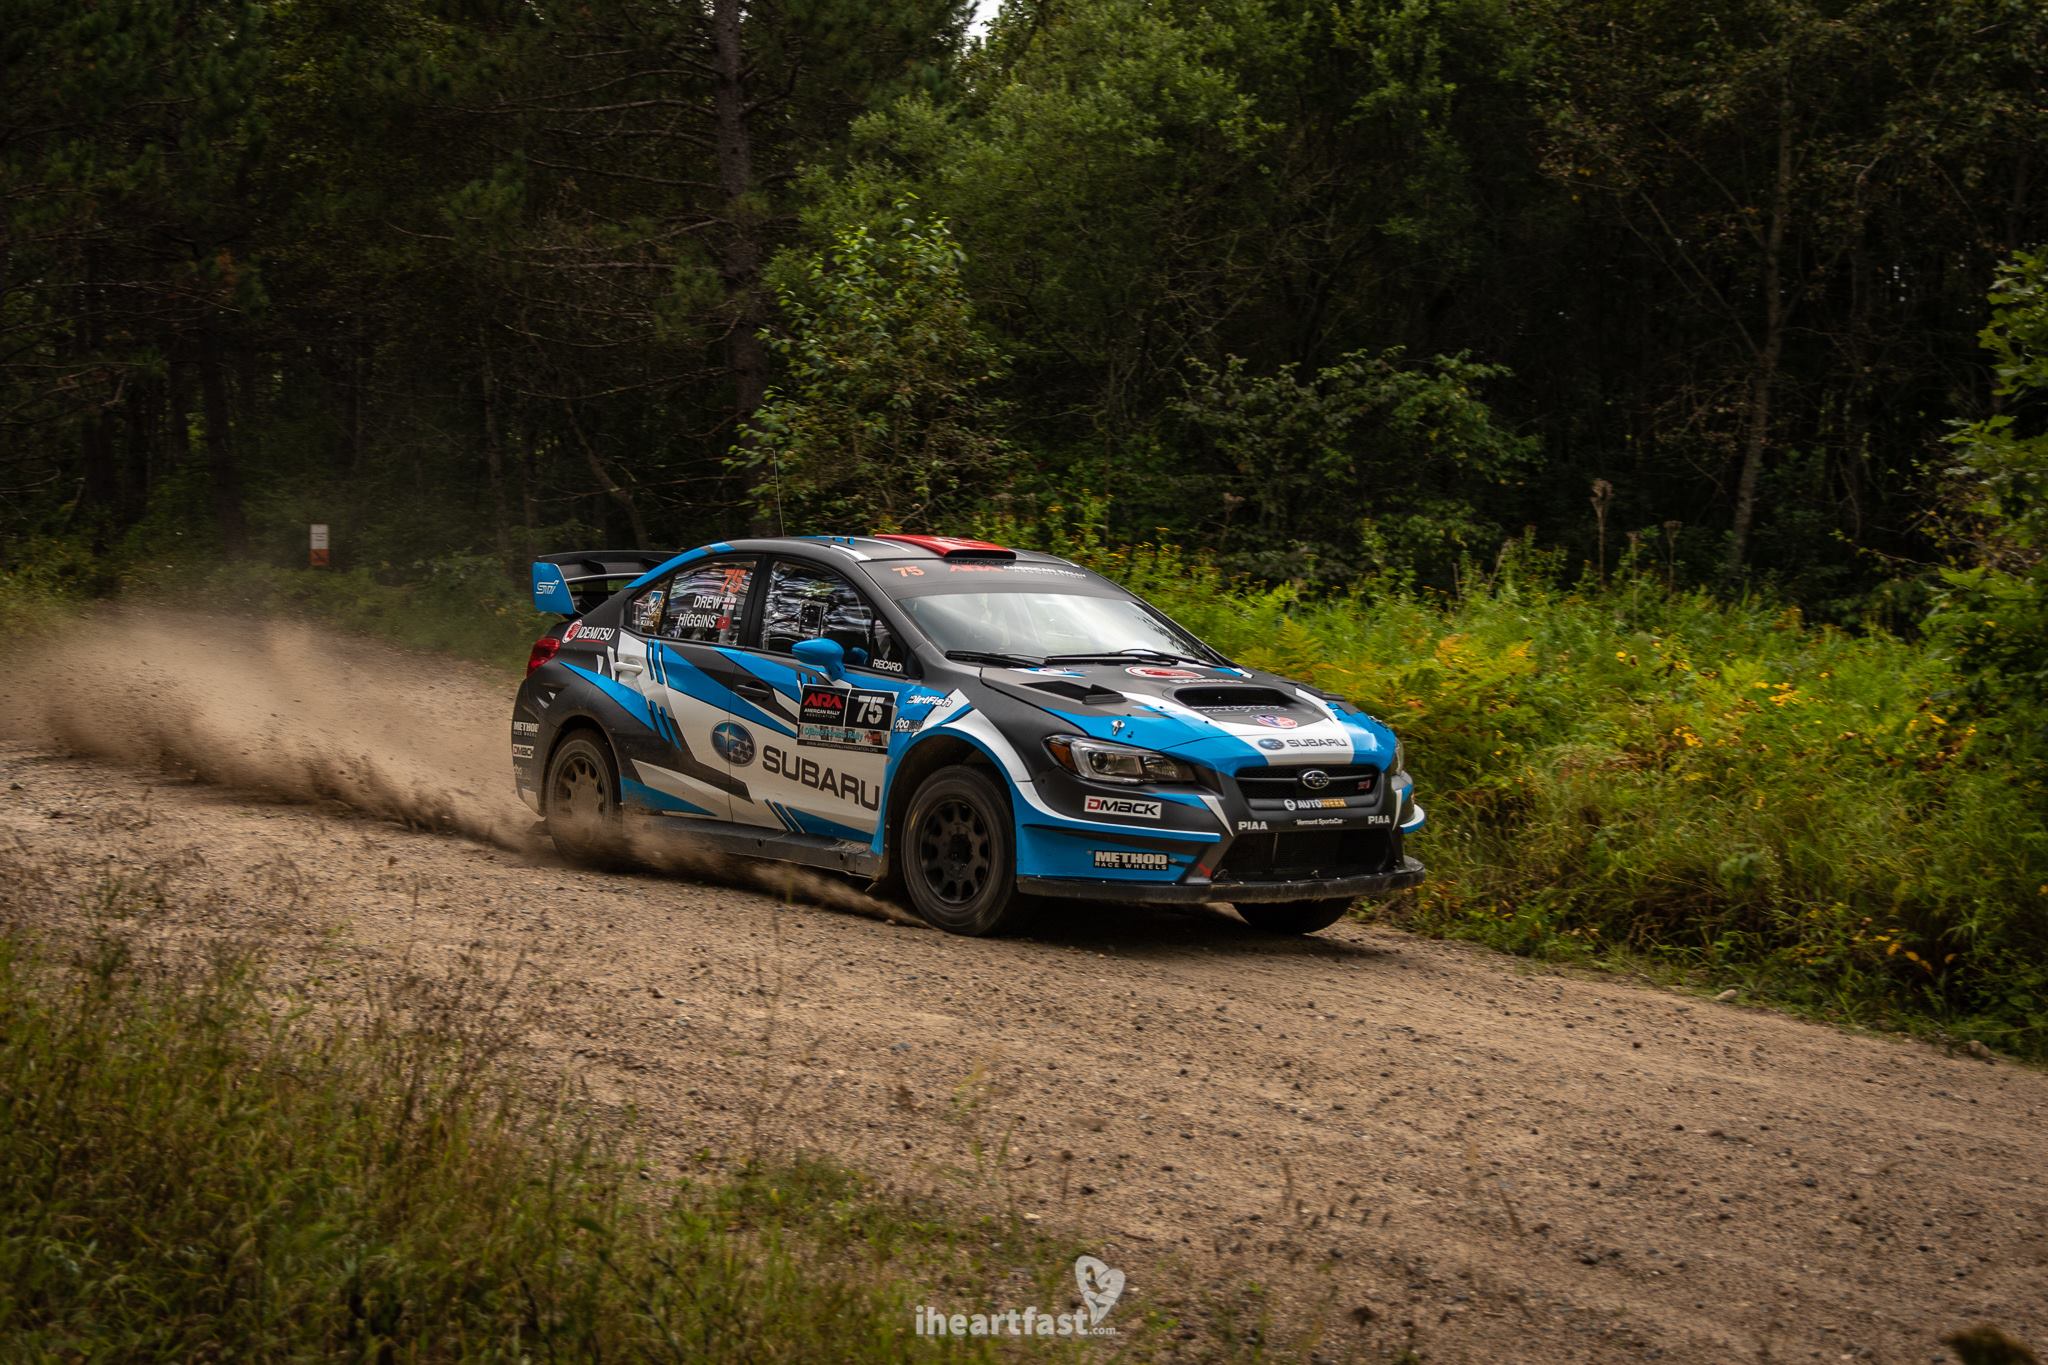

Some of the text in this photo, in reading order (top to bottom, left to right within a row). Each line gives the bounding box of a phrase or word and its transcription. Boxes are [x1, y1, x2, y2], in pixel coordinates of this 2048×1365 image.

[892, 565, 925, 577] 75
[536, 580, 559, 595] STI
[720, 568, 747, 593] 75
[693, 595, 723, 609] DREW
[677, 612, 717, 628] HIGGINS
[576, 626, 615, 641] IDEMITSU
[872, 658, 902, 672] RECARO
[803, 692, 885, 724] ARA 75
[1286, 738, 1349, 748] SUBARU
[762, 745, 880, 811] SUBARU
[1297, 799, 1347, 810] AUTOWEEK
[1238, 820, 1269, 831] PIAA
[1296, 817, 1344, 826] Vermont SportsCar
[1367, 815, 1391, 825] PIAA
[1095, 851, 1168, 865] METHOD
